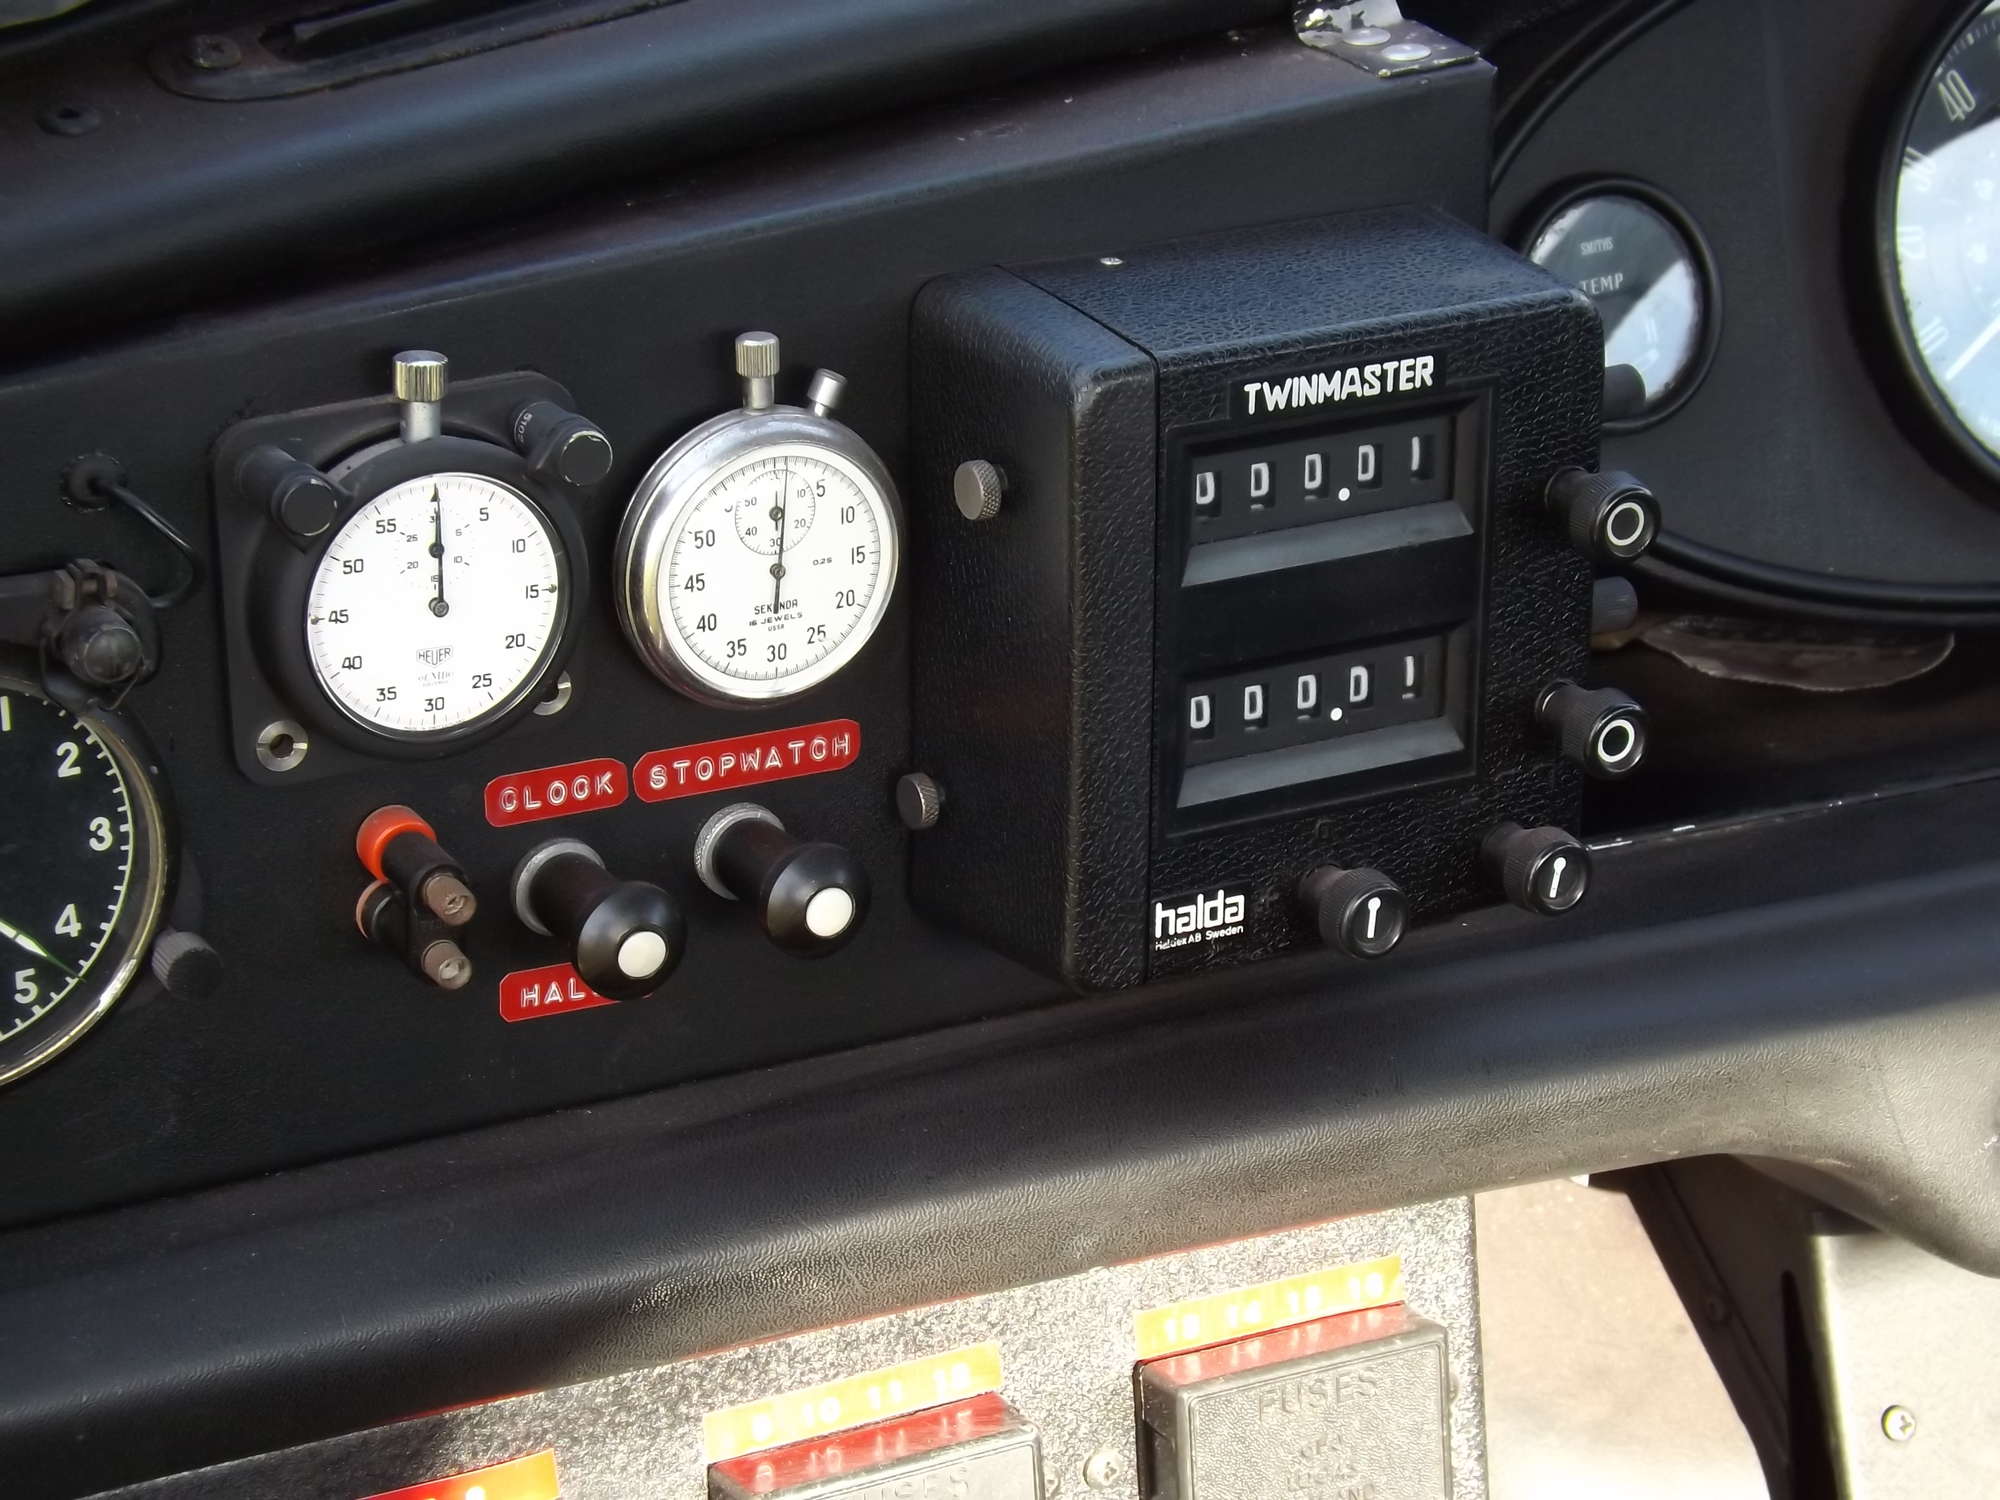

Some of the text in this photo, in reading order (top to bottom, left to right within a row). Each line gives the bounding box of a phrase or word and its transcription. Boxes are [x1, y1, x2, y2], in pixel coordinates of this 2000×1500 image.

[1936, 69, 1977, 121] 40
[1580, 236, 1614, 256] SMITHS
[1579, 272, 1623, 295] TEMP
[1244, 355, 1434, 415] TWINMASTER
[797, 488, 806, 498] 10
[816, 479, 826, 497] 5
[479, 507, 489, 521] 5
[794, 518, 806, 529] 20
[840, 506, 855, 525] 10
[375, 519, 397, 534] 55
[745, 526, 758, 536] 40
[406, 534, 418, 542] 25
[512, 539, 525, 553] 10
[694, 530, 716, 549] 50
[769, 537, 782, 548] 30
[406, 561, 418, 569] 20
[454, 556, 463, 564] 10
[851, 546, 865, 565] 15
[342, 559, 364, 574] 50
[525, 584, 539, 599] 15
[684, 573, 705, 592] 45
[754, 599, 798, 615] SEKNDA
[835, 590, 855, 609] 20
[328, 609, 349, 624] 45
[696, 613, 717, 632] 40
[761, 612, 803, 625] JEWELS
[505, 633, 525, 649] 20
[807, 625, 826, 645] 25
[418, 647, 451, 665] HEUER
[726, 639, 747, 658] 35
[766, 643, 787, 662] 30
[341, 655, 362, 670] 40
[472, 673, 492, 689] 25
[376, 686, 397, 702] 35
[424, 697, 445, 712] 30
[56, 741, 81, 778] 2
[649, 733, 851, 790] STOPWATCH
[499, 771, 614, 813] CLOCK
[88, 817, 113, 851] 3
[55, 904, 82, 937] 4
[1155, 889, 1245, 939] halda
[1188, 932, 1202, 944] AB
[1205, 925, 1244, 940] Sweden
[14, 968, 38, 1004] 5
[521, 976, 599, 1008] HAL
[1258, 1367, 1378, 1421] FUSES
